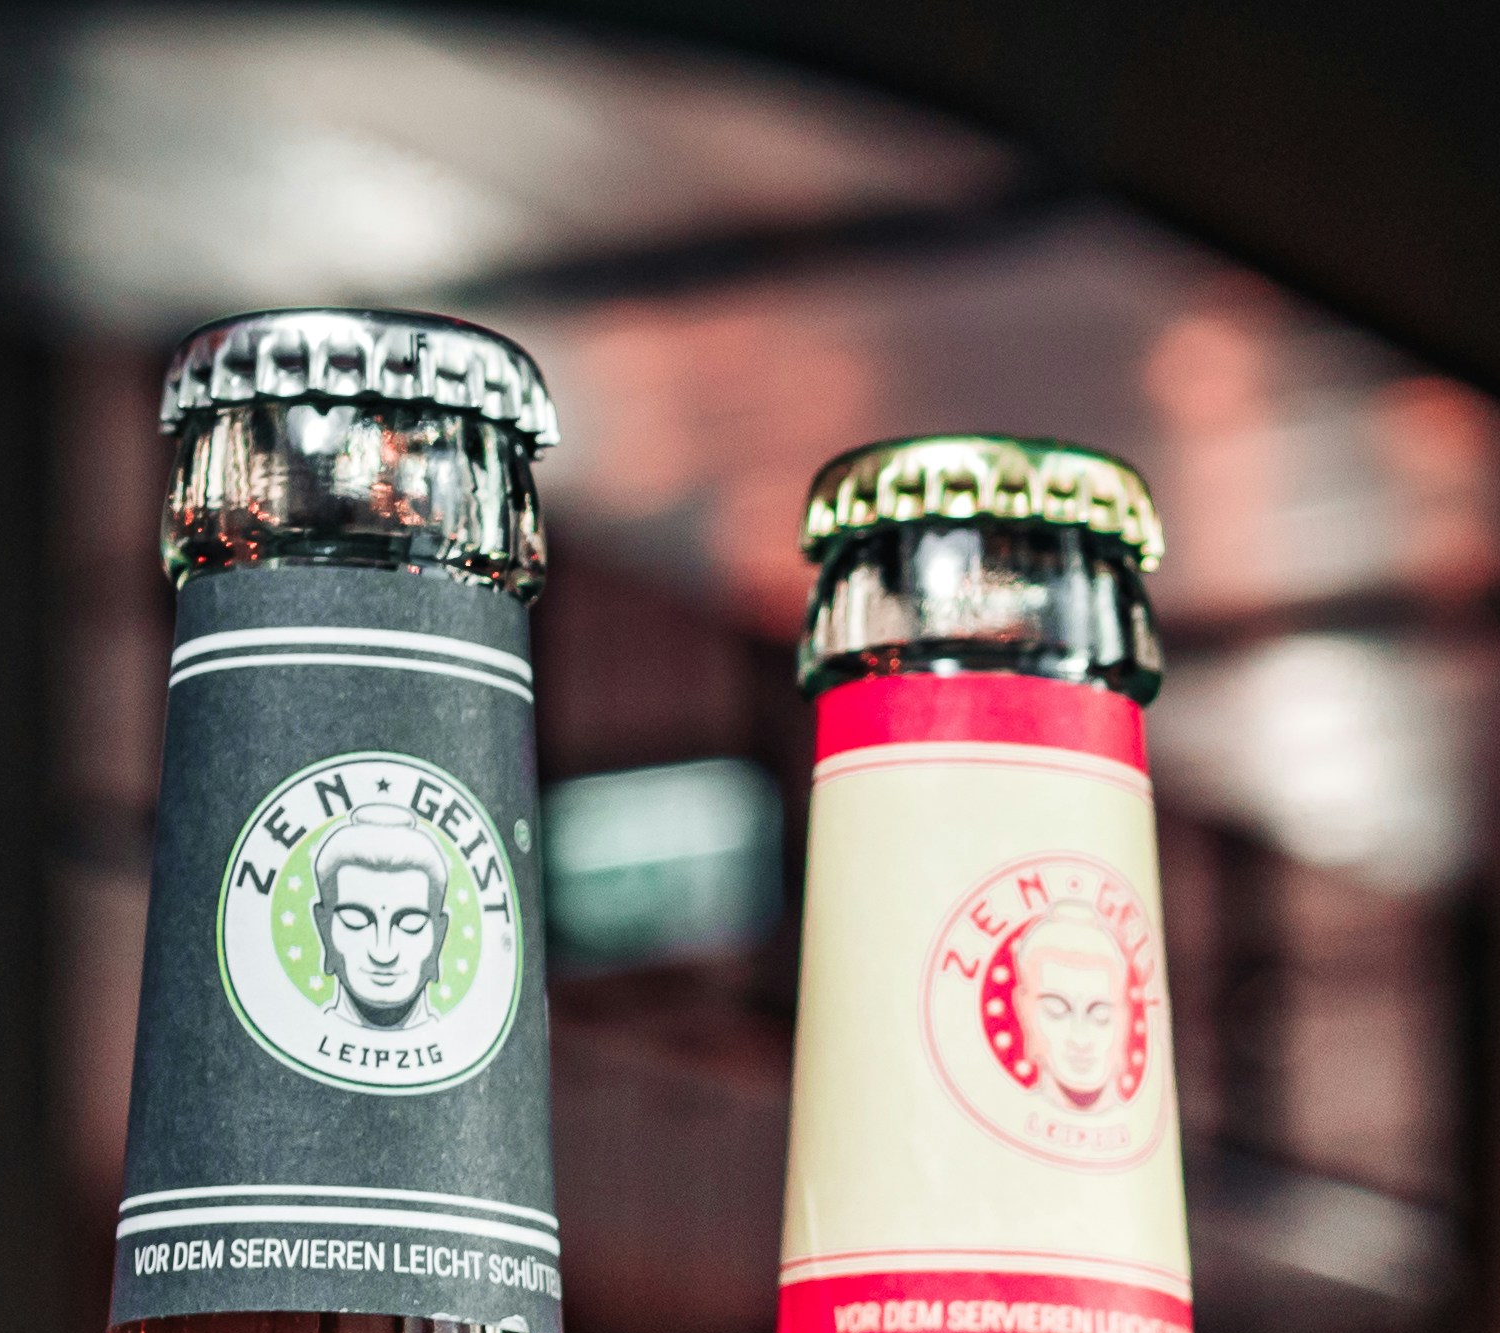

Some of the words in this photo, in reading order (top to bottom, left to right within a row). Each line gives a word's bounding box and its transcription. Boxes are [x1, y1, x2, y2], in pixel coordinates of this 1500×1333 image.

[236, 772, 357, 897] ZEN
[410, 777, 511, 924] GEIST
[317, 1036, 444, 1070] LEIPZIG
[134, 1243, 170, 1277] VOR
[172, 1239, 225, 1272] DEM
[229, 1238, 385, 1272] SERVIEREN
[393, 1244, 484, 1281] LEICHT
[884, 1300, 943, 1333] DEM
